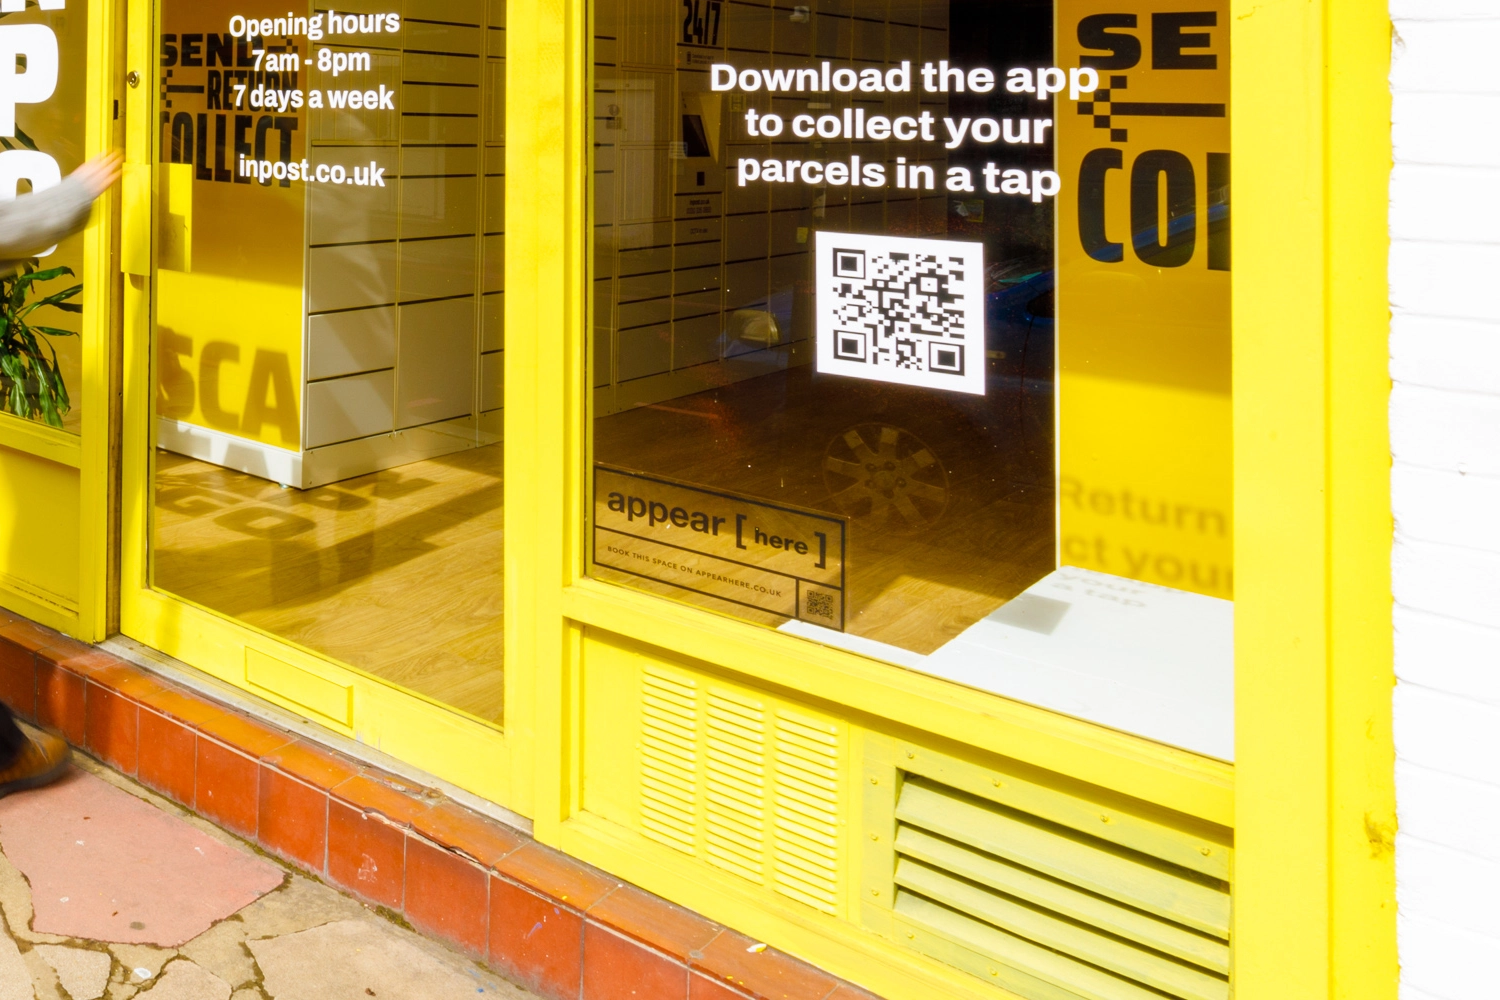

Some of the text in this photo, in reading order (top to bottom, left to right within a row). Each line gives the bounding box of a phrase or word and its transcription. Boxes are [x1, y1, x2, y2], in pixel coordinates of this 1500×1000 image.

[229, 9, 400, 42] Opening hours
[160, 33, 264, 67] SEND
[252, 49, 300, 72] 7am
[317, 47, 371, 77] 8pm
[207, 69, 298, 113] RETURN
[233, 82, 395, 113] 7 days a week
[711, 60, 1099, 100] Download the app
[744, 108, 1053, 149] to collect your
[239, 153, 386, 187] inpost.co.uk
[738, 155, 1061, 203] parcels in a tap
[607, 491, 726, 537] appear
[607, 546, 782, 598] BOOK THIS SPACE ON APPEARHERE.CO.UK
